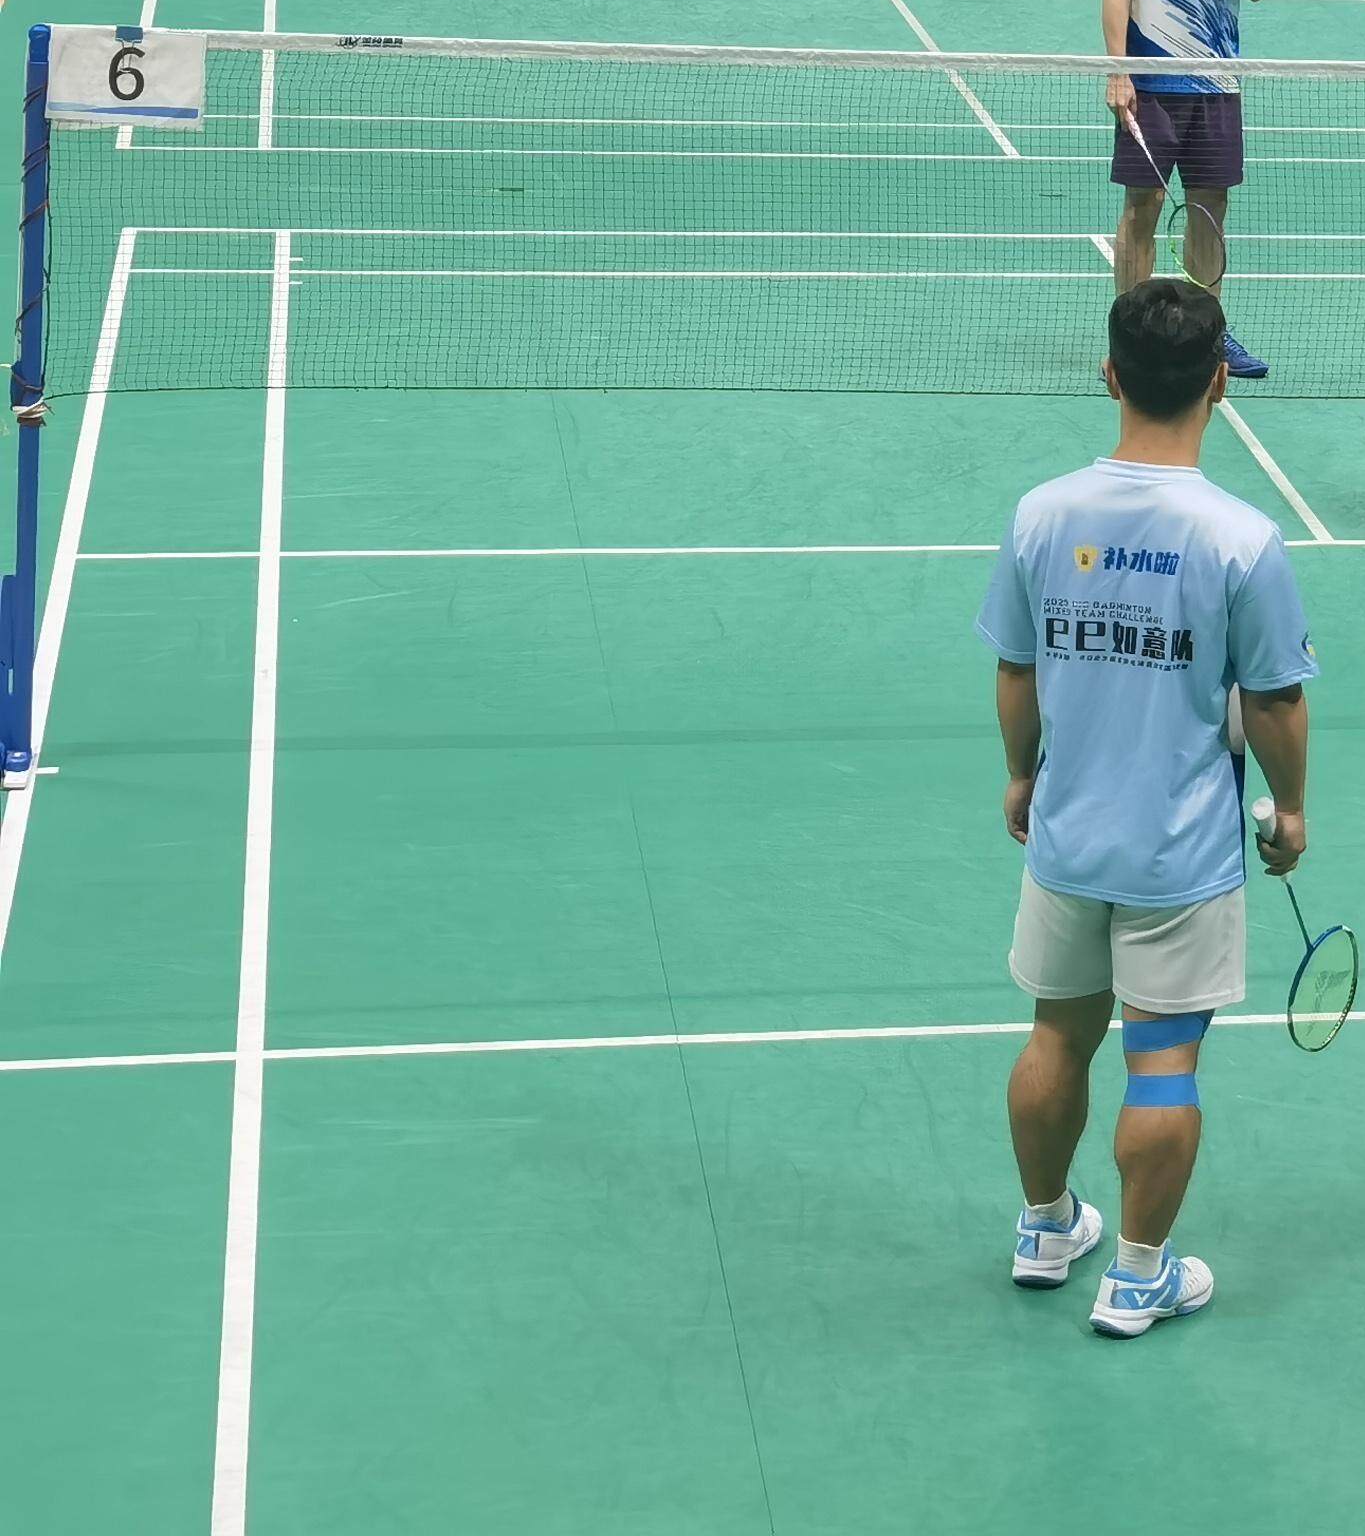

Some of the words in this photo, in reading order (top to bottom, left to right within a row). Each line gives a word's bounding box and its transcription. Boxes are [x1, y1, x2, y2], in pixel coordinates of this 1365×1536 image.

[108, 45, 146, 102] 6
[1103, 547, 1181, 576] 补水啦
